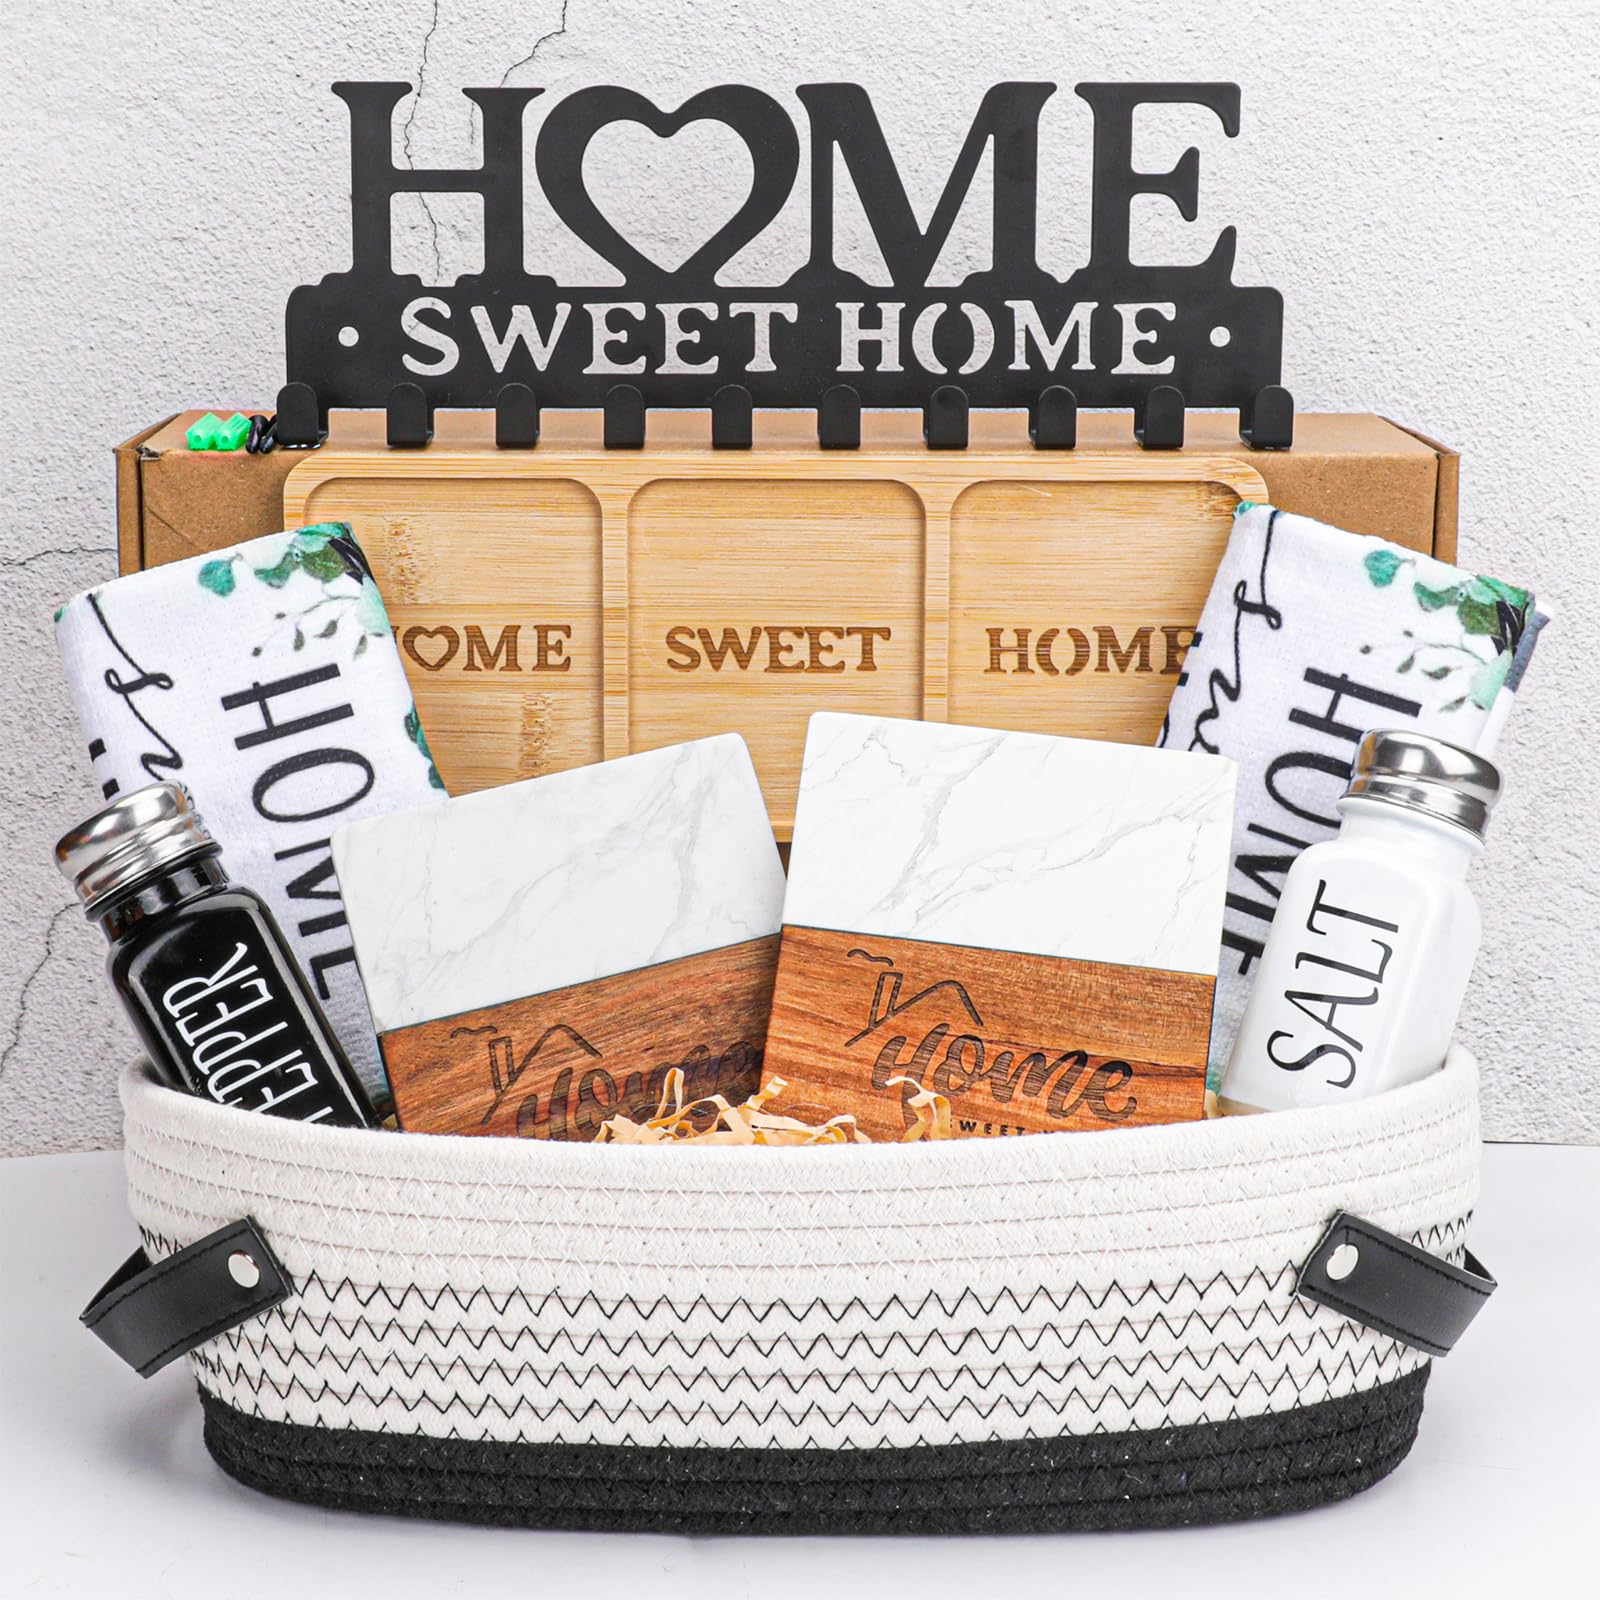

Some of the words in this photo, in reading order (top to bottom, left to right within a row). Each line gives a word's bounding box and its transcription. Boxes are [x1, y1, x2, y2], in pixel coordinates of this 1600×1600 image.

[400, 296, 798, 376] SWEET
[835, 299, 1176, 375] HOME
[391, 625, 572, 672] OME
[665, 625, 892, 673] SWEET
[984, 625, 1198, 675] HOME
[1266, 879, 1399, 1089] SALT
[162, 942, 333, 1123] EPPER
[872, 1023, 1137, 1130] Home
[949, 1118, 1025, 1136] WEET
